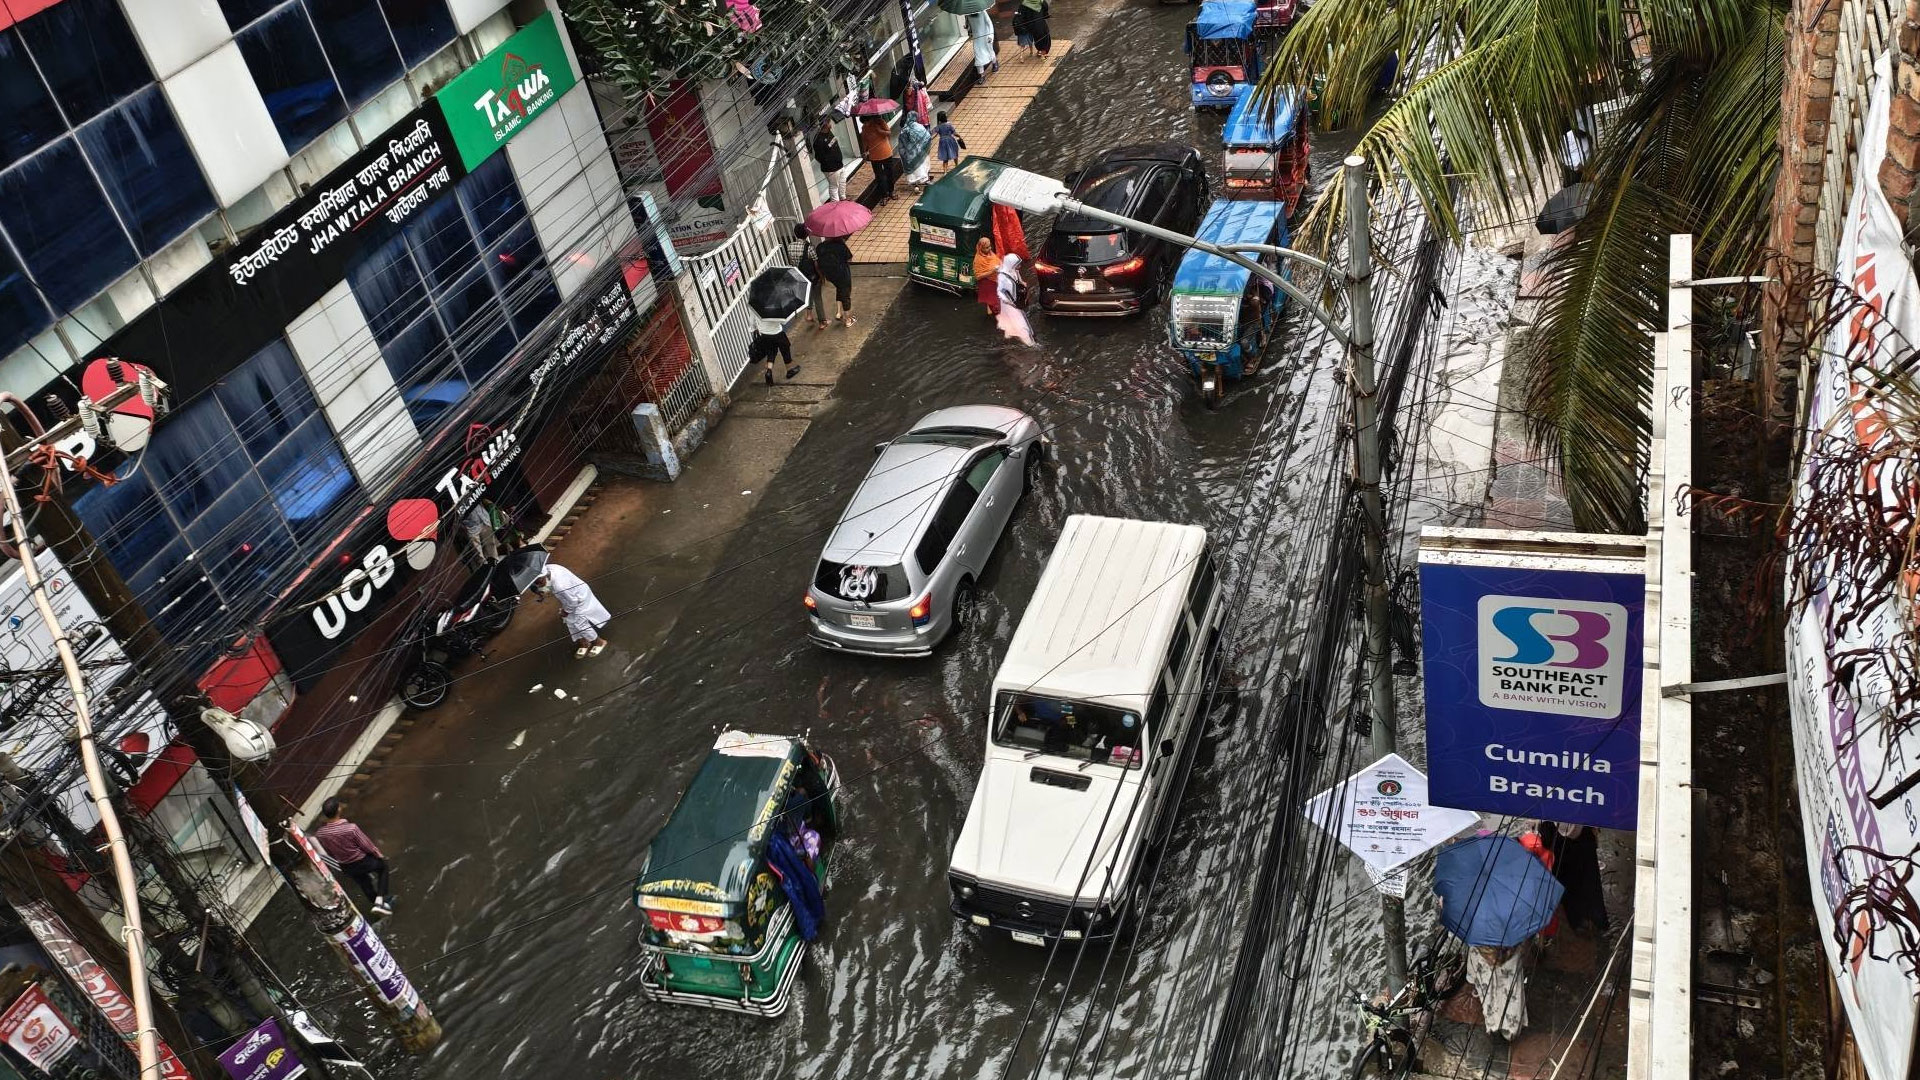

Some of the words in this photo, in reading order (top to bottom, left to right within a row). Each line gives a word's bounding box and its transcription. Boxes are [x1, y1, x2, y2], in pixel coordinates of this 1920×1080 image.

[494, 115, 522, 142] ISLAMIC
[526, 88, 554, 115] BANKING
[229, 223, 300, 285] ইউনাইটেড
[296, 177, 358, 232] কমার্শিয়াল
[356, 152, 390, 187] ব্যাংক
[388, 118, 433, 165] পিএলসি
[310, 185, 387, 254] JHAWTALA
[387, 141, 442, 193] BRANCH
[385, 187, 429, 224] ঝাউতলা
[427, 165, 450, 190] শাখা
[563, 323, 601, 366] JHAWTALA
[456, 482, 487, 515] ISLAMIC
[491, 445, 522, 479] BANKING
[312, 544, 396, 640] UCB
[1492, 666, 1607, 685] SOUTHEAST
[1500, 679, 1553, 694] BANK
[1558, 685, 1598, 698] PLC.
[1503, 693, 1533, 702] BANK
[1536, 697, 1565, 706] WITH
[1568, 700, 1607, 709] VISION
[1484, 743, 1611, 774] Cumilla
[1489, 775, 1605, 806] Branch
[1356, 808, 1377, 817] শুভ
[1380, 806, 1419, 821] উদ্বোধন
